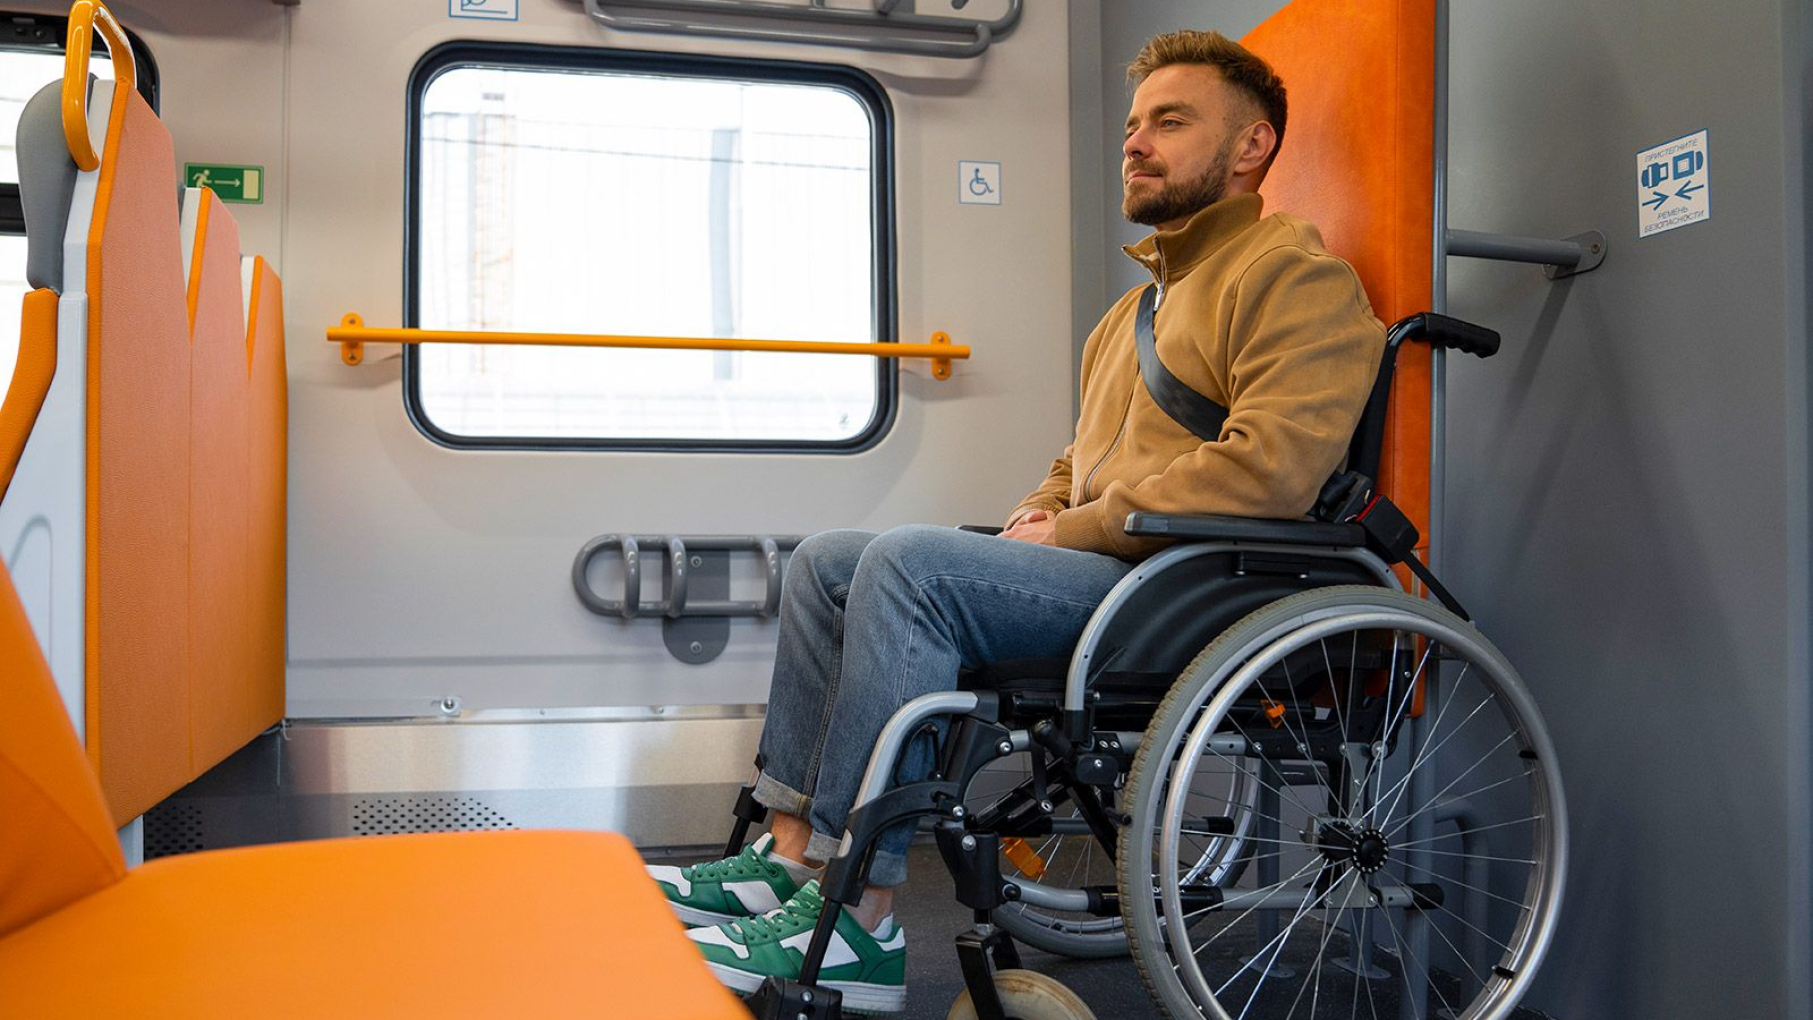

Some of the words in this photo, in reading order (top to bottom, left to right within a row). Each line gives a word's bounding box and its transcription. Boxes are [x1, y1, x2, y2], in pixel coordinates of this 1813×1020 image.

[1644, 138, 1698, 162] ПРИСТЕГНИТЕ
[1644, 210, 1704, 233] БЕЗОПАСНОСТИ
[1657, 206, 1688, 220] РЕМЕНЬ
